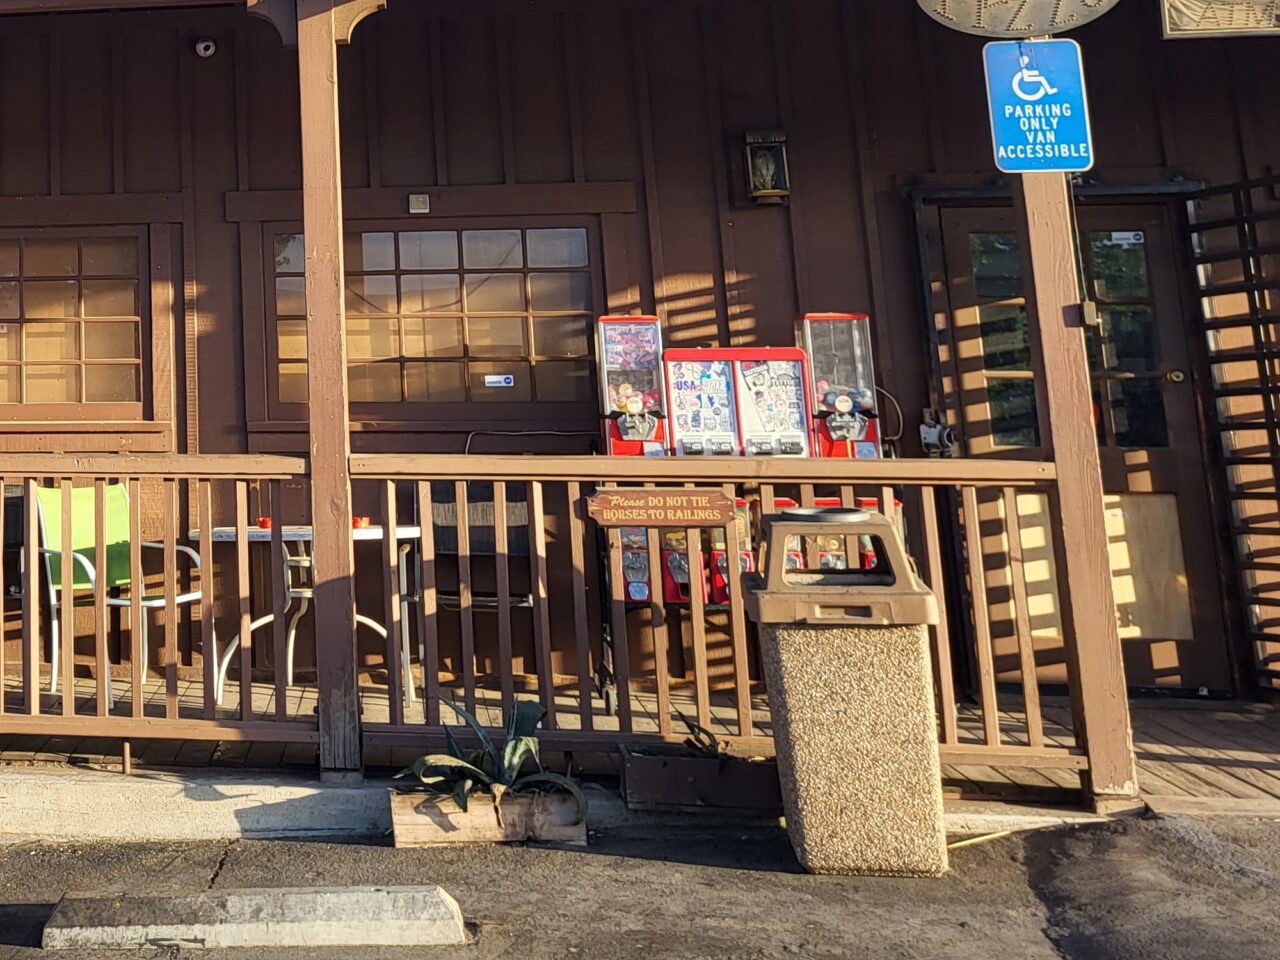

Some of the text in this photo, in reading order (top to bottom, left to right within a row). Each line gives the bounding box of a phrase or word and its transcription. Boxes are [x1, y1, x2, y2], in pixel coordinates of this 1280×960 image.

[1195, 0, 1275, 28] ATM
[1004, 103, 1072, 118] PARKING
[1020, 116, 1059, 131] ONLY
[1026, 130, 1056, 144] VAN
[998, 143, 1089, 159] ACCESSIBLE
[676, 380, 696, 391] USA
[609, 495, 710, 507] Please DO NOT TIE
[603, 509, 721, 520] HORSES TO RAILINGS
